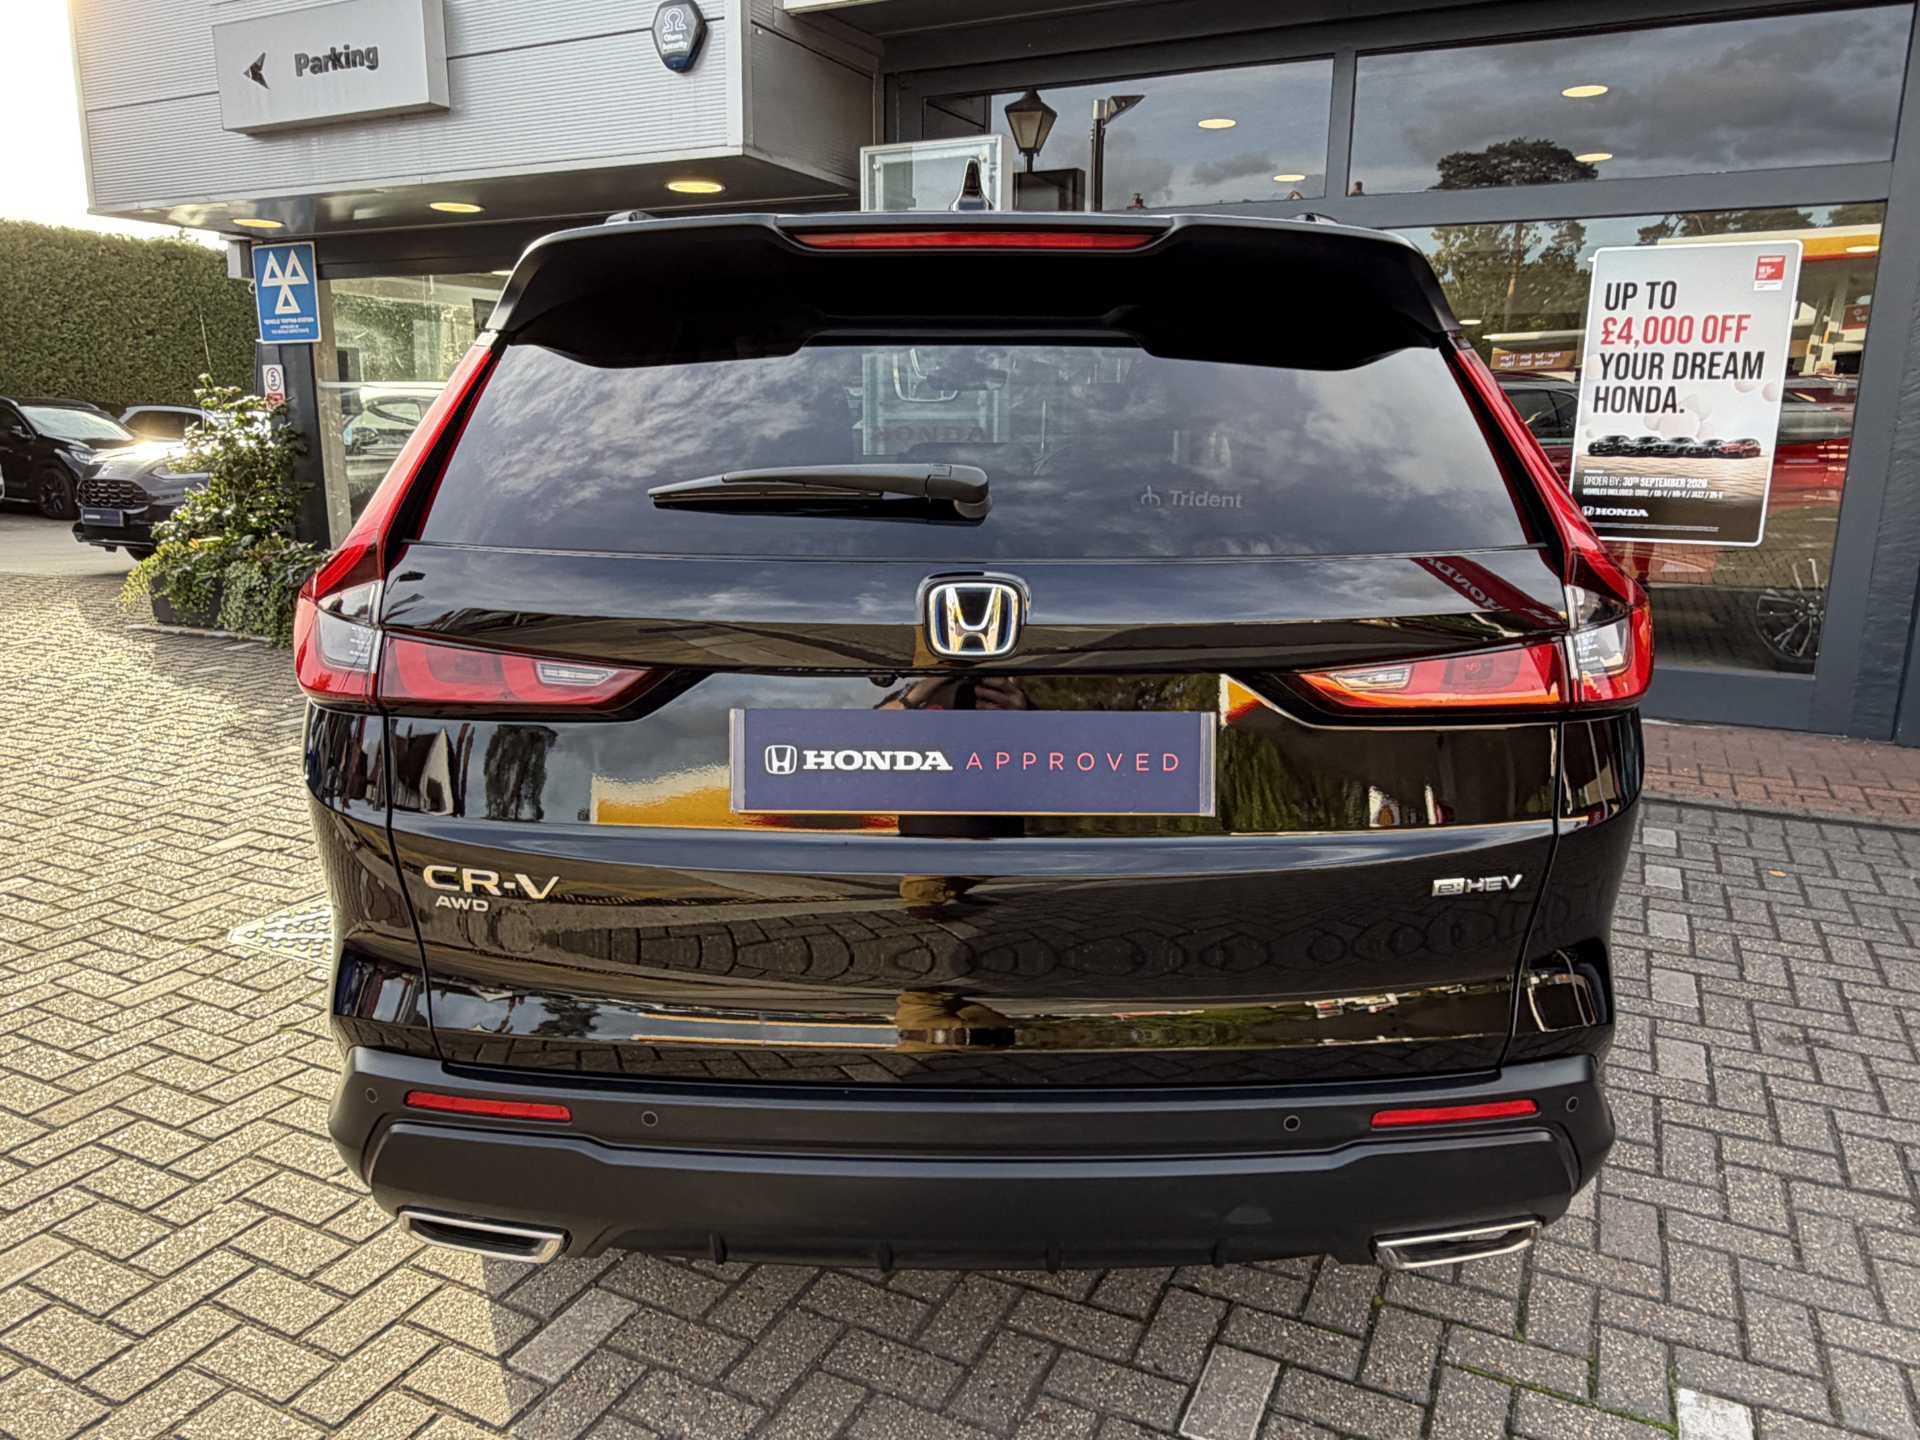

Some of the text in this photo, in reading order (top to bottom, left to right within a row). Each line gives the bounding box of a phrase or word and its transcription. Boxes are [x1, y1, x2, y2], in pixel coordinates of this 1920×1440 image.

[294, 44, 379, 77] Parking
[1604, 281, 1678, 311] UP TO
[1600, 314, 1752, 348] £4,000 OFF
[1600, 351, 1765, 380] YOUR DREAM
[1593, 386, 1685, 414] HONDA.
[1169, 489, 1243, 508] Trident
[1595, 507, 1648, 517] HONDA
[803, 750, 953, 771] HONDA
[966, 752, 1181, 772] APPROVED
[423, 865, 560, 900] CR-V
[435, 895, 489, 912] AWD
